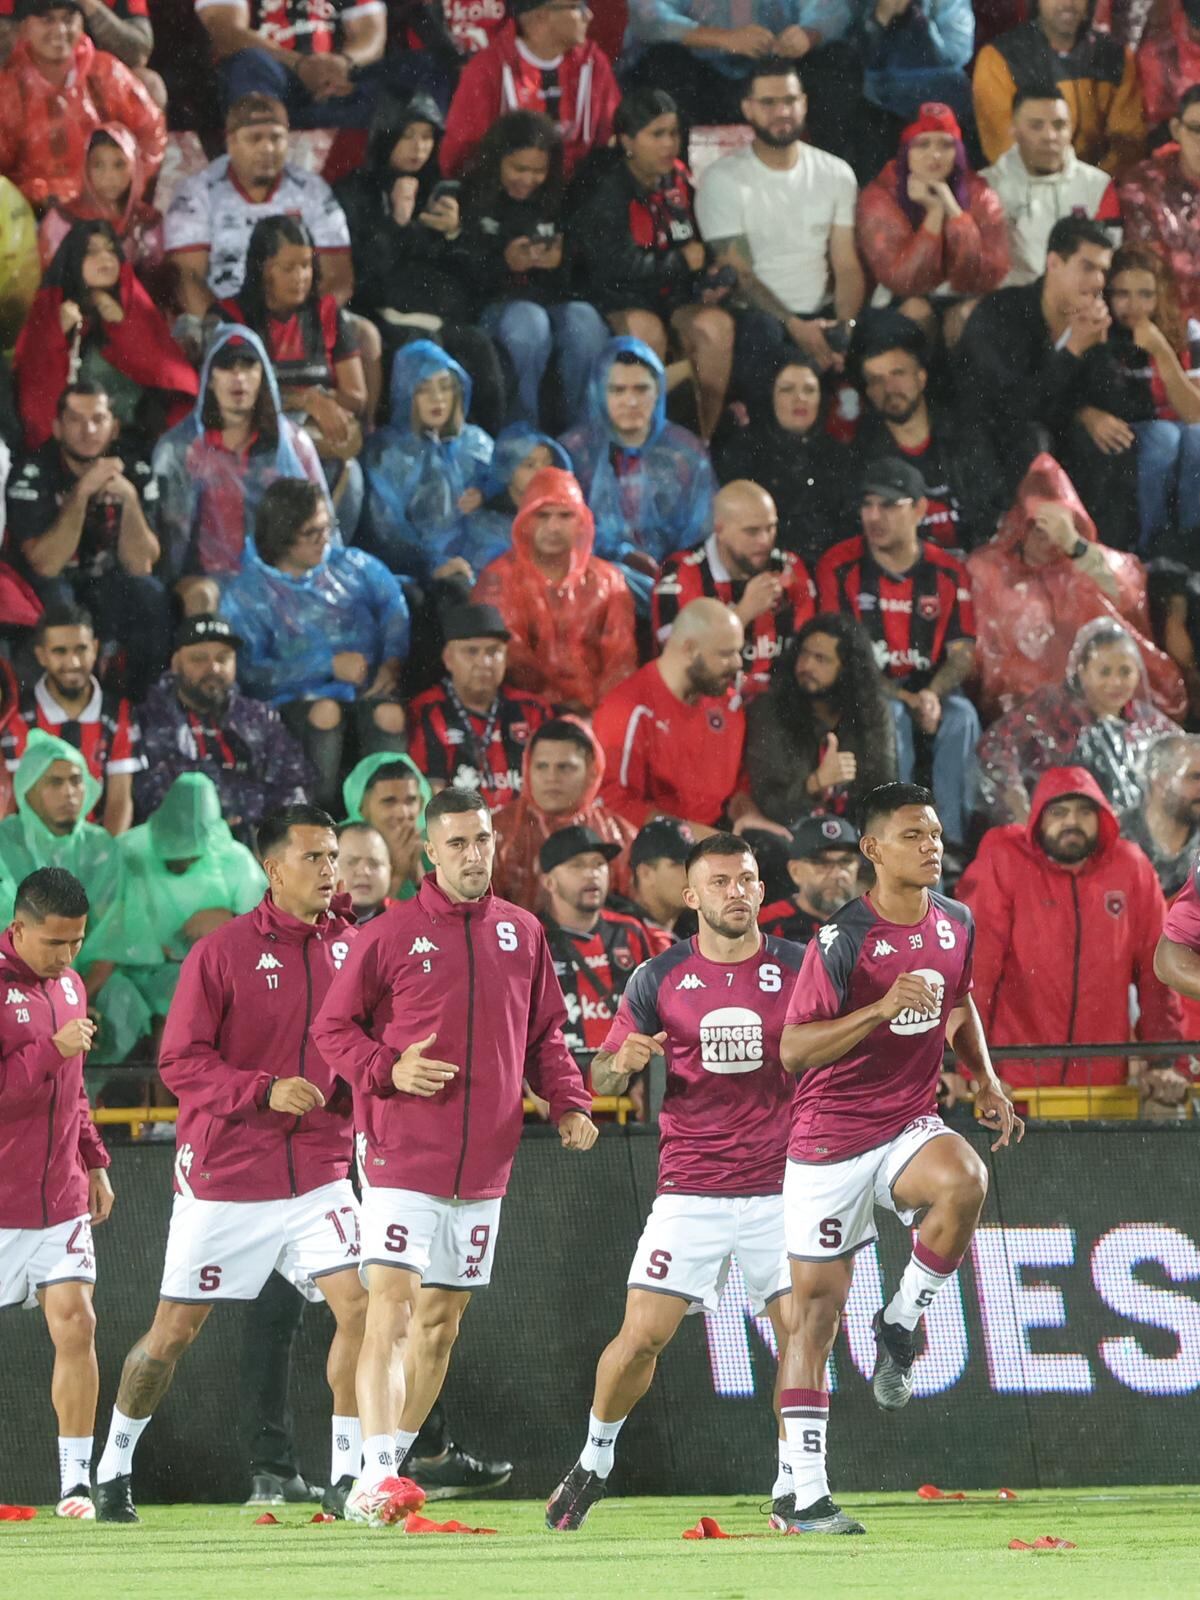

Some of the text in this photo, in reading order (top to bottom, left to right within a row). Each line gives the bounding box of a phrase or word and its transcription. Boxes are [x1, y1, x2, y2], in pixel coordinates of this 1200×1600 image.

[496, 921, 518, 951] S
[908, 933, 923, 949] 39
[936, 919, 956, 950] S
[422, 959, 431, 973] 9
[758, 963, 782, 992] S
[60, 976, 79, 1005] S
[265, 974, 278, 989] 17
[726, 973, 734, 987] 7
[15, 1008, 30, 1023] 28
[700, 1025, 763, 1043] BURGER
[701, 1040, 764, 1061] KING
[384, 1223, 408, 1253] S
[466, 1225, 490, 1264] 9
[818, 1217, 842, 1249] S
[646, 1249, 672, 1280] S
[198, 1265, 222, 1292] S
[802, 1429, 821, 1453] S
